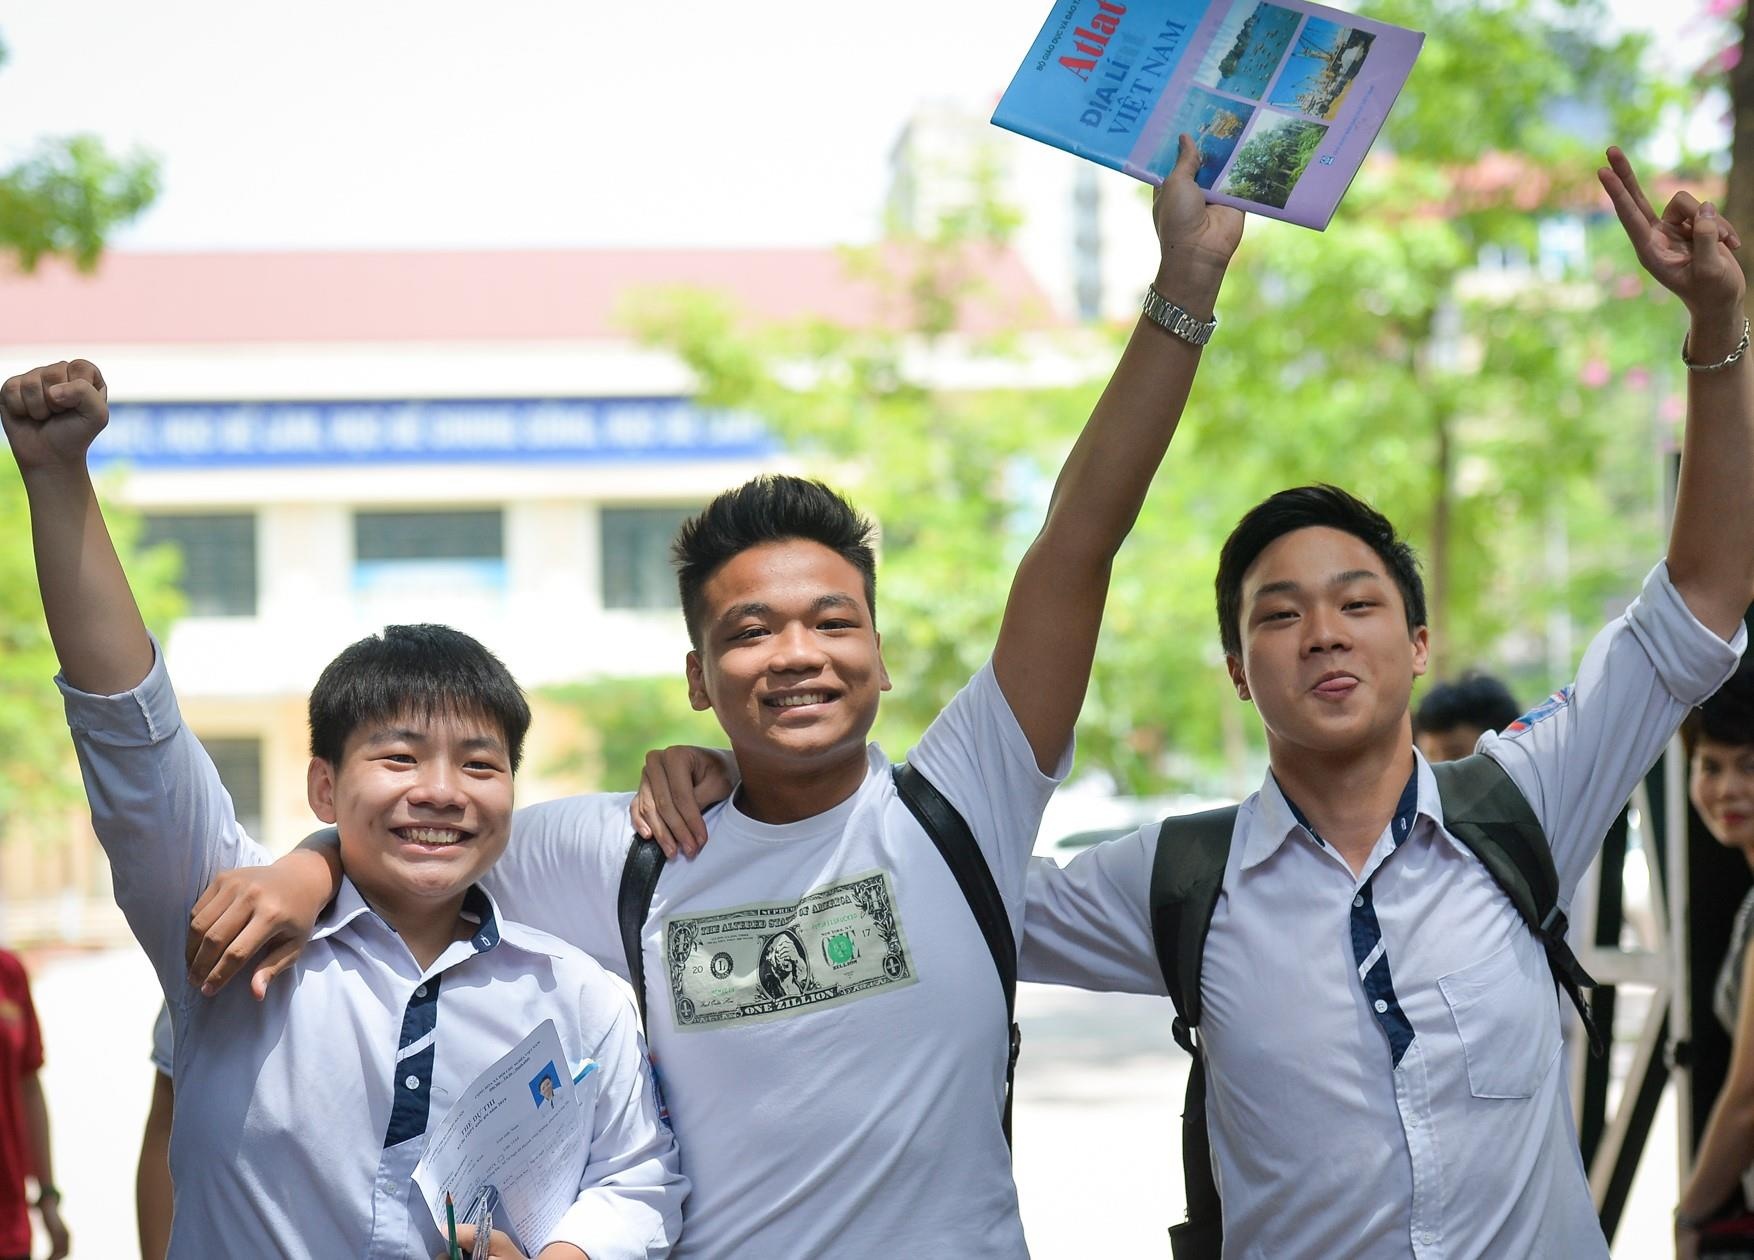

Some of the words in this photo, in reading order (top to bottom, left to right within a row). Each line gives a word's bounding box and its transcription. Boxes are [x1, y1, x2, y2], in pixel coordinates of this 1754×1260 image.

[1058, 0, 1127, 82] Atlat
[1080, 87, 1119, 128] ĐỊA
[1105, 57, 1131, 83] LÍ
[1107, 79, 1153, 134] VIỆT
[1141, 19, 1187, 78] NAM
[700, 924, 720, 936] THE
[721, 919, 767, 933] ALTERED
[812, 895, 852, 913] AMERICA
[861, 928, 871, 938] 17
[693, 965, 704, 975] 20
[718, 960, 726, 971] L
[744, 1004, 773, 1016] ONE
[774, 989, 837, 1011] ZILLION
